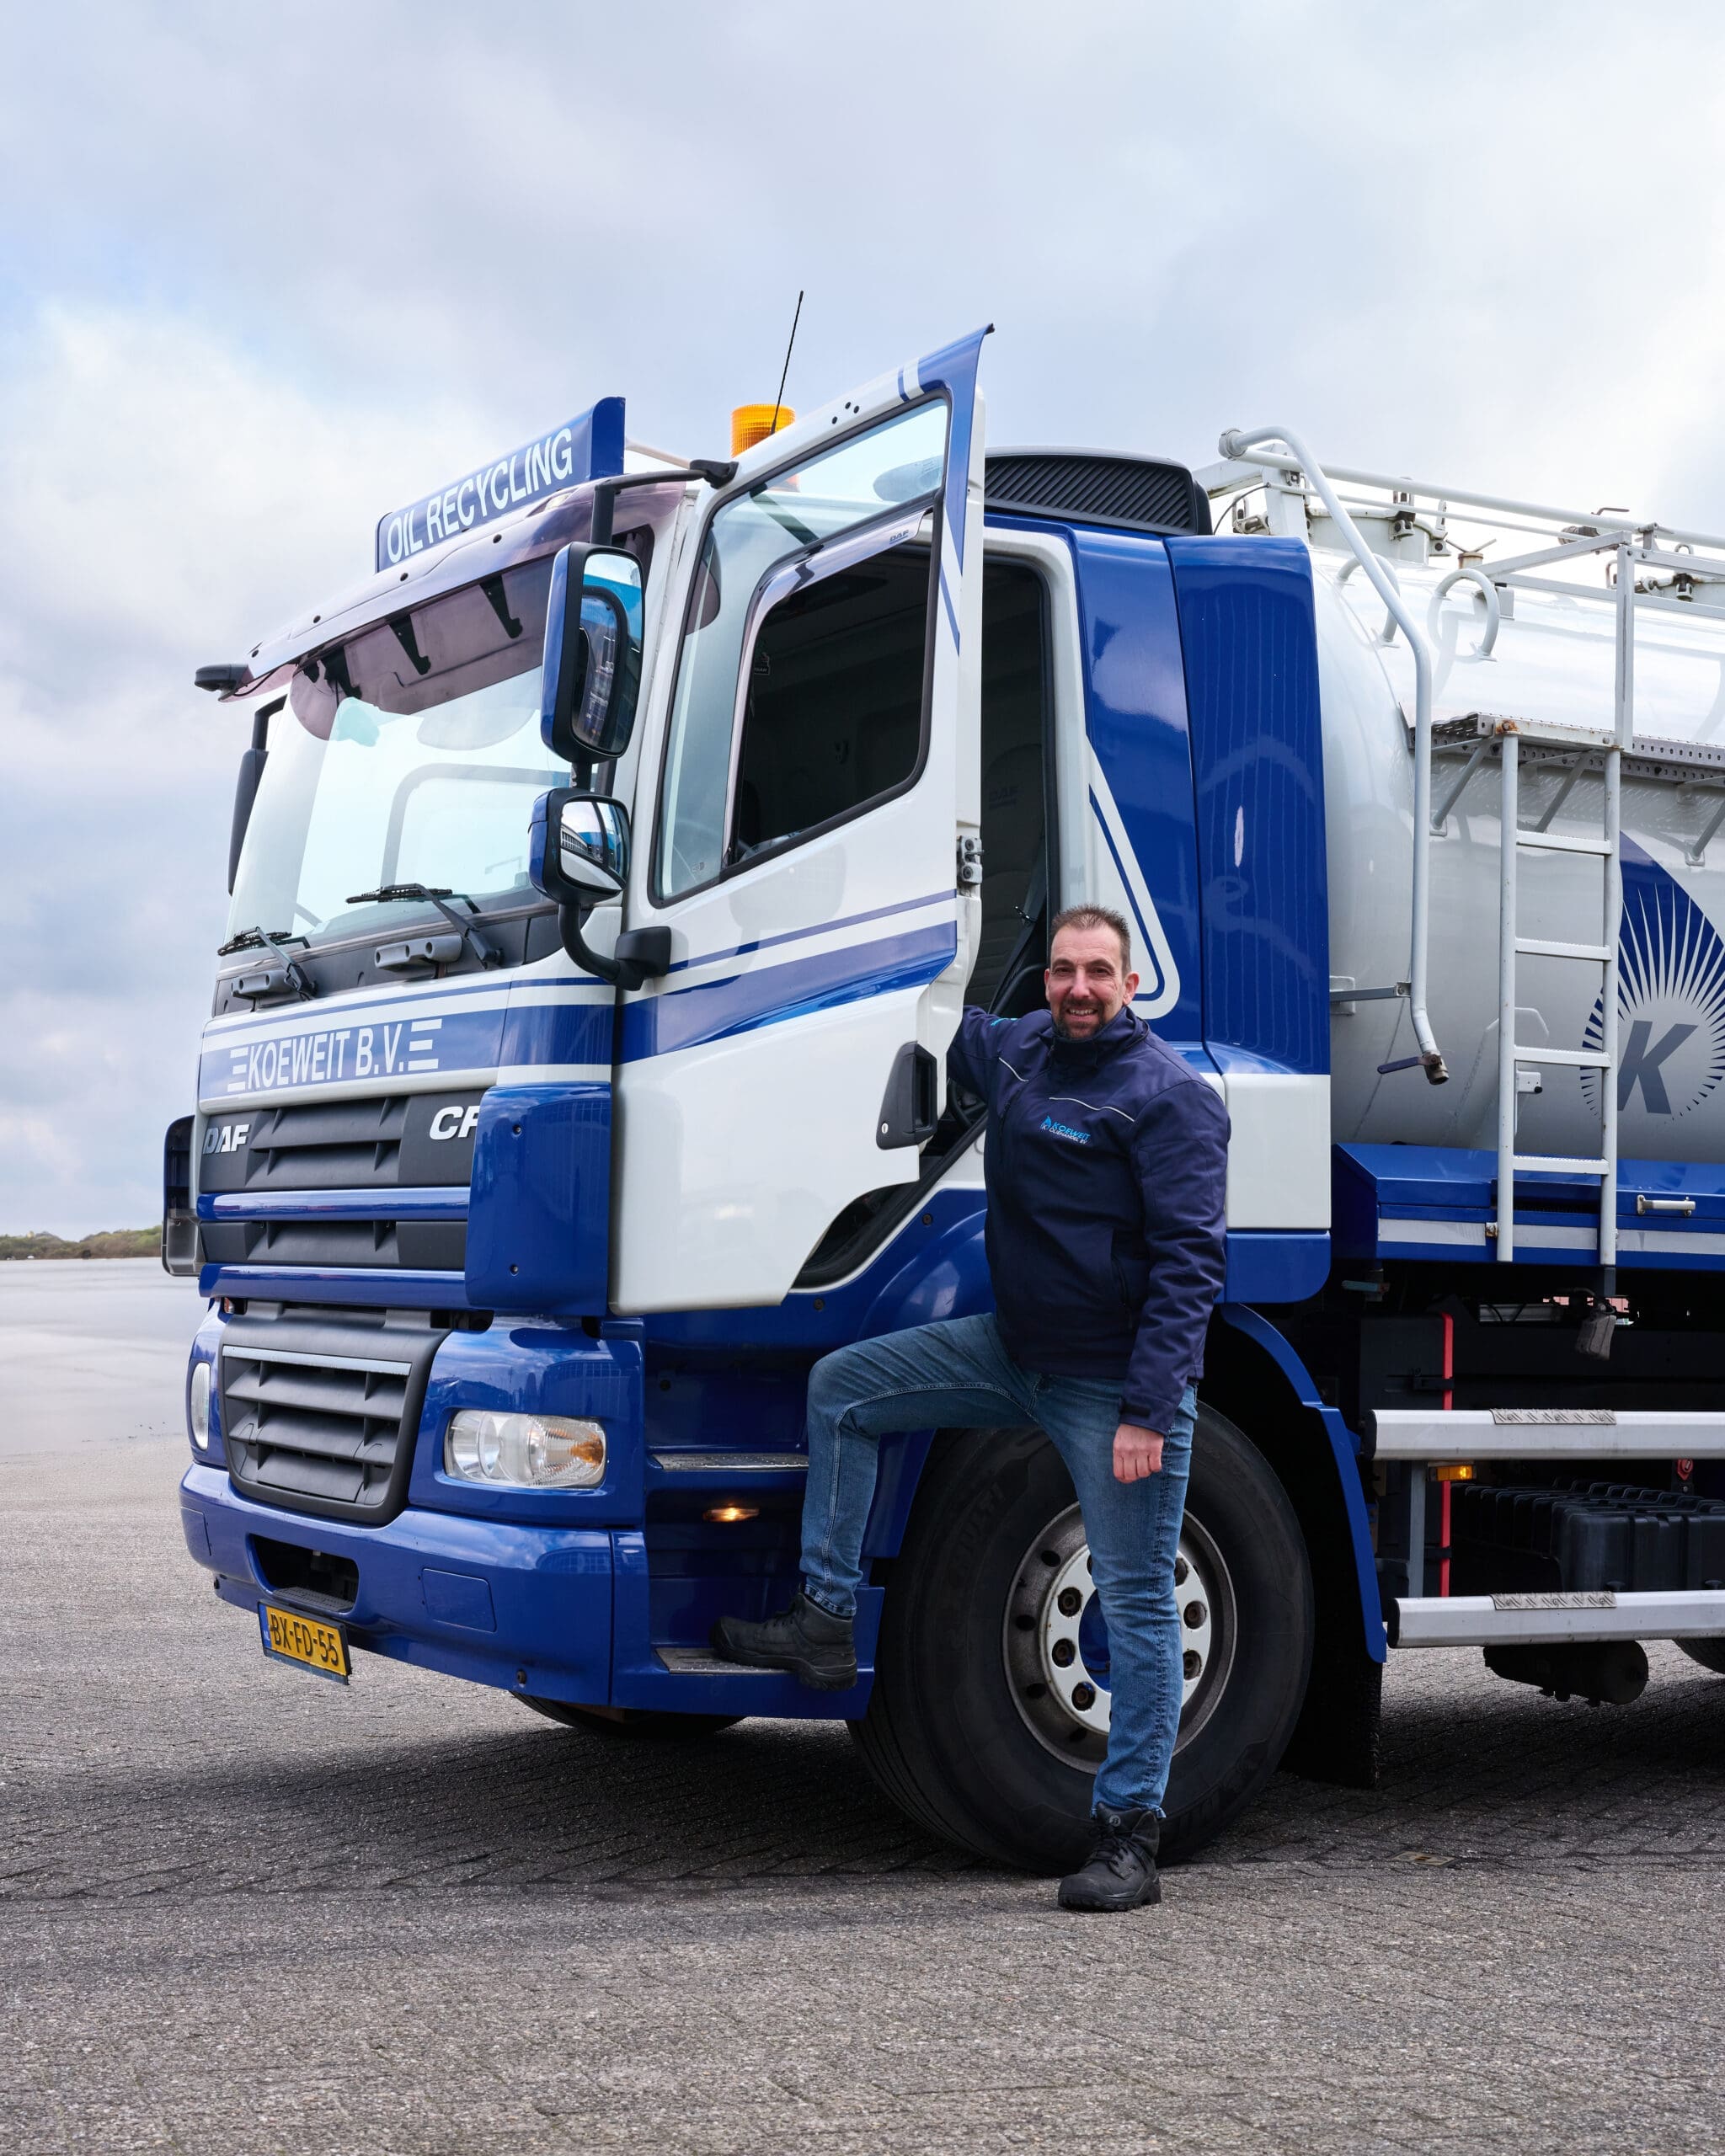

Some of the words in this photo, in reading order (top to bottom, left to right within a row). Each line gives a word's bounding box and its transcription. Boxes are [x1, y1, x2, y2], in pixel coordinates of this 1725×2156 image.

[387, 511, 424, 563] OIL
[426, 428, 573, 544] RECYCLING
[248, 1030, 350, 1090] KOEWEIT
[355, 1023, 403, 1076] B.V.
[1616, 1019, 1699, 1115] K
[203, 1123, 250, 1155] DAF
[1052, 1121, 1091, 1140] KOEWEIT
[270, 1613, 339, 1667] BX-FD-55
